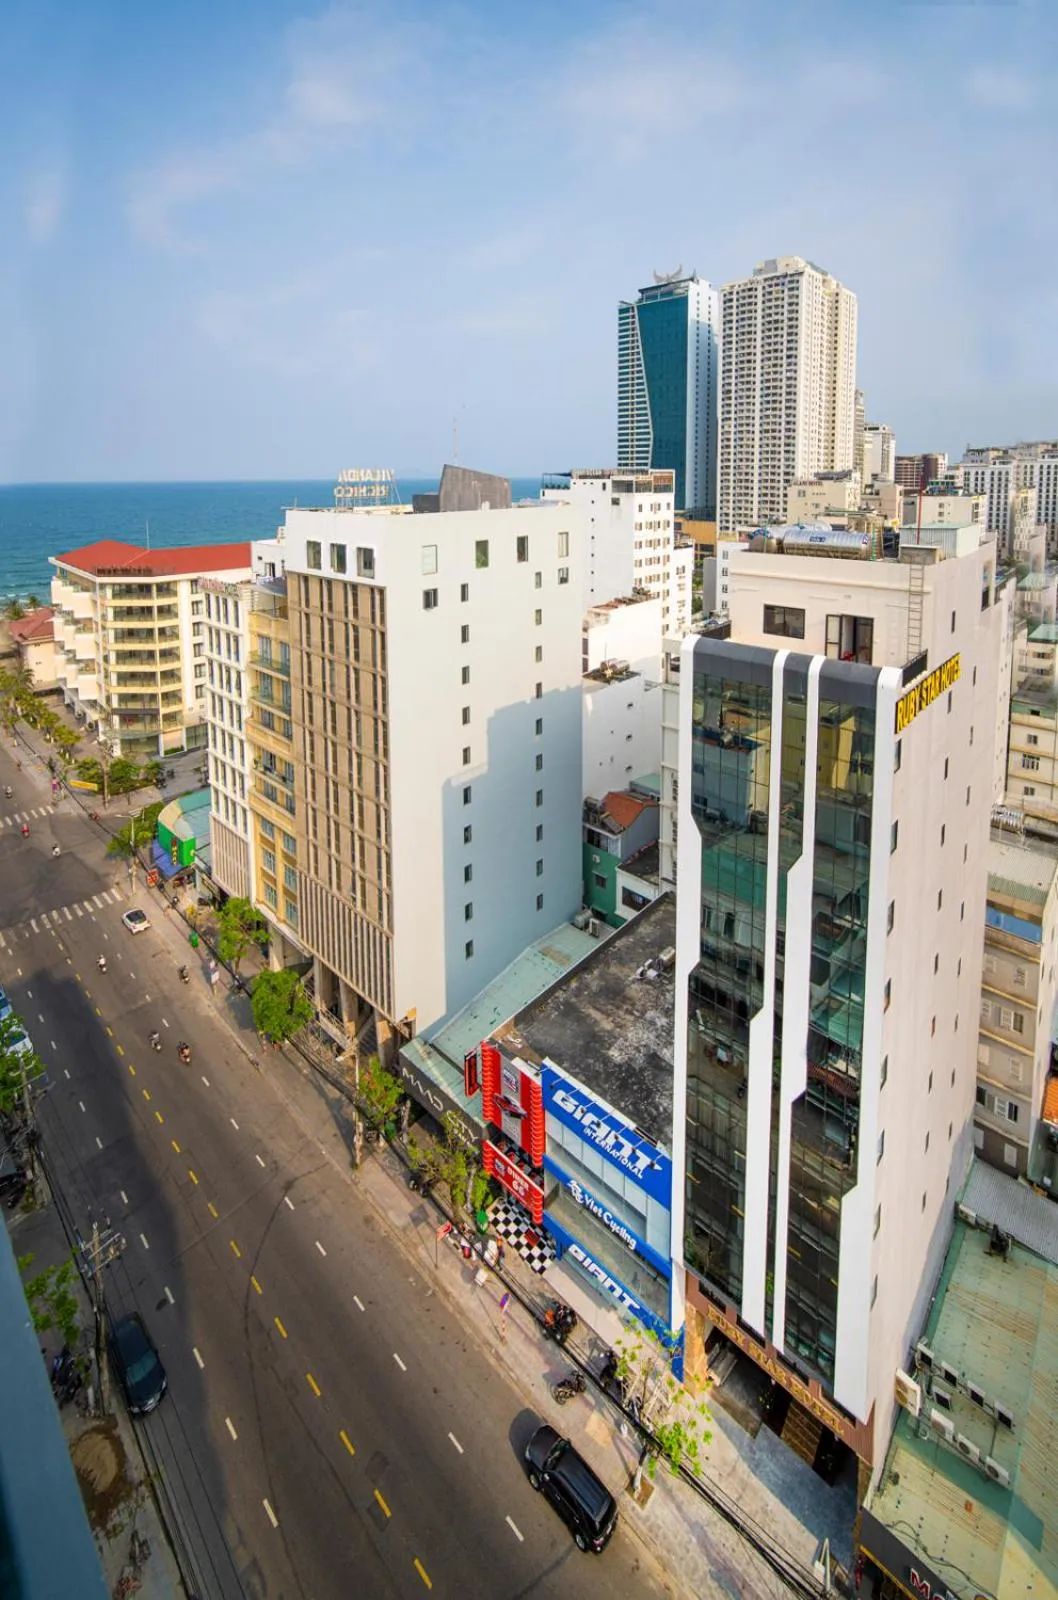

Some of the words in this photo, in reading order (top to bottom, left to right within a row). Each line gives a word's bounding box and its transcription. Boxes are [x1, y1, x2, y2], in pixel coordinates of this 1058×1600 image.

[896, 686, 921, 733] RUBY
[920, 669, 941, 711] STAR
[941, 653, 961, 691] HOTEL
[552, 1089, 663, 1172] GIANT
[583, 1126, 644, 1180] INTERNATIONAL
[602, 1211, 637, 1251] Cycling
[568, 1243, 641, 1310] GIANT
